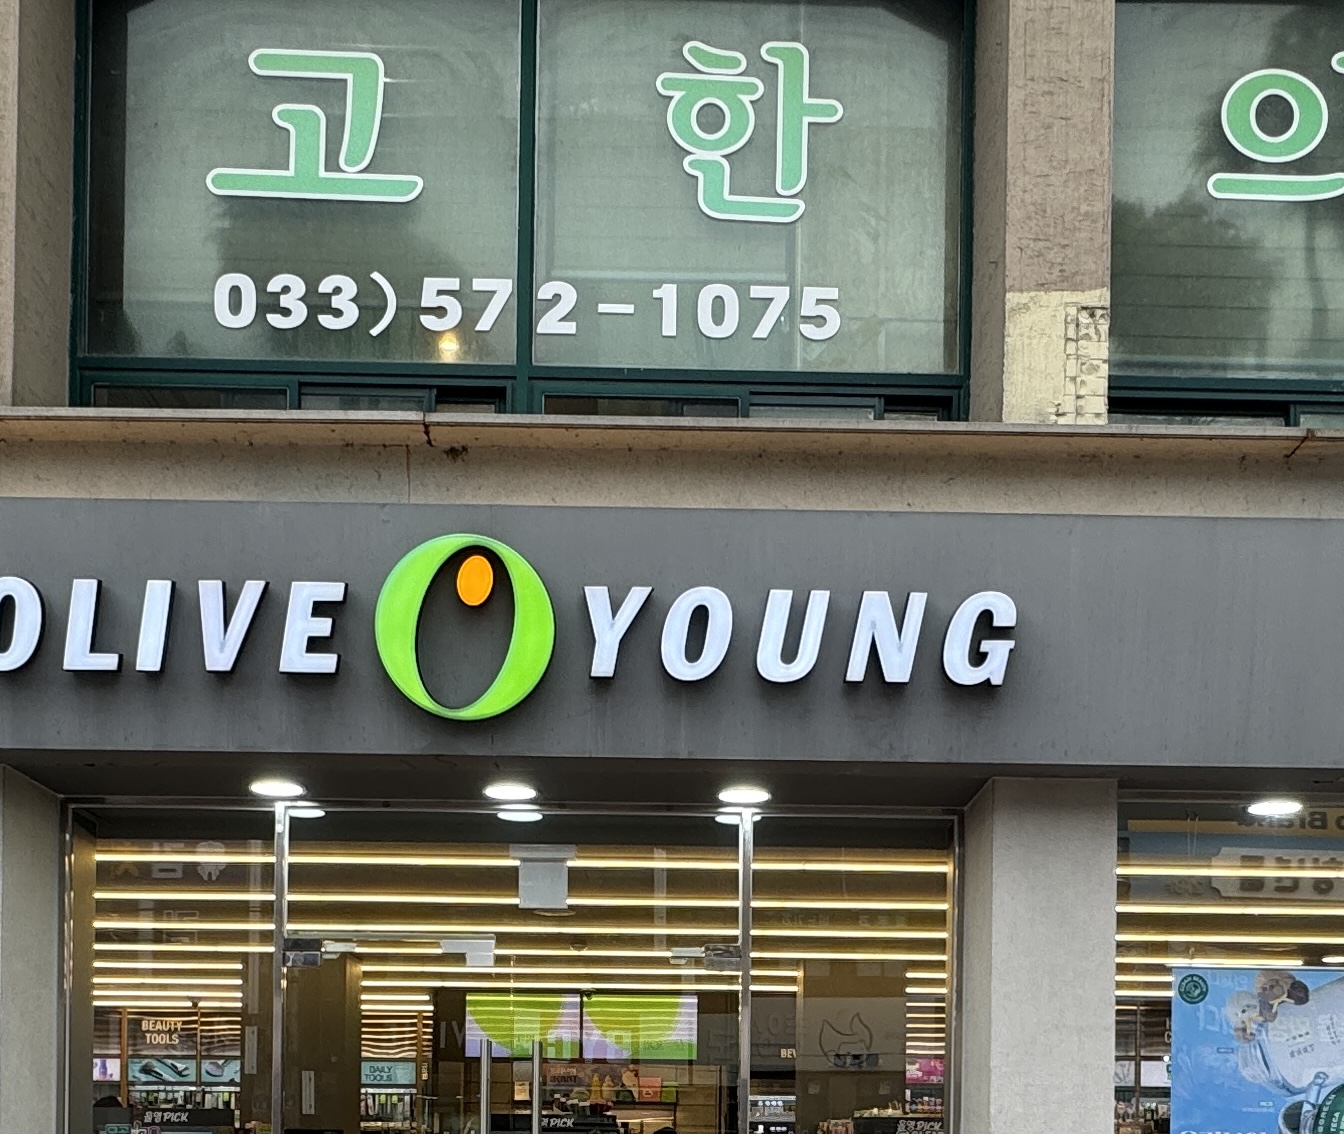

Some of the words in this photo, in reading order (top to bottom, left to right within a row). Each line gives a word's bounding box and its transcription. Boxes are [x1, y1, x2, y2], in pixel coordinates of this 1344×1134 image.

[213, 271, 842, 341] 033)572-1075
[582, 585, 1018, 687] YOUNG
[141, 1020, 183, 1031] BEAUTY
[144, 1033, 180, 1045] TOOLS
[369, 1065, 393, 1074] DAILY
